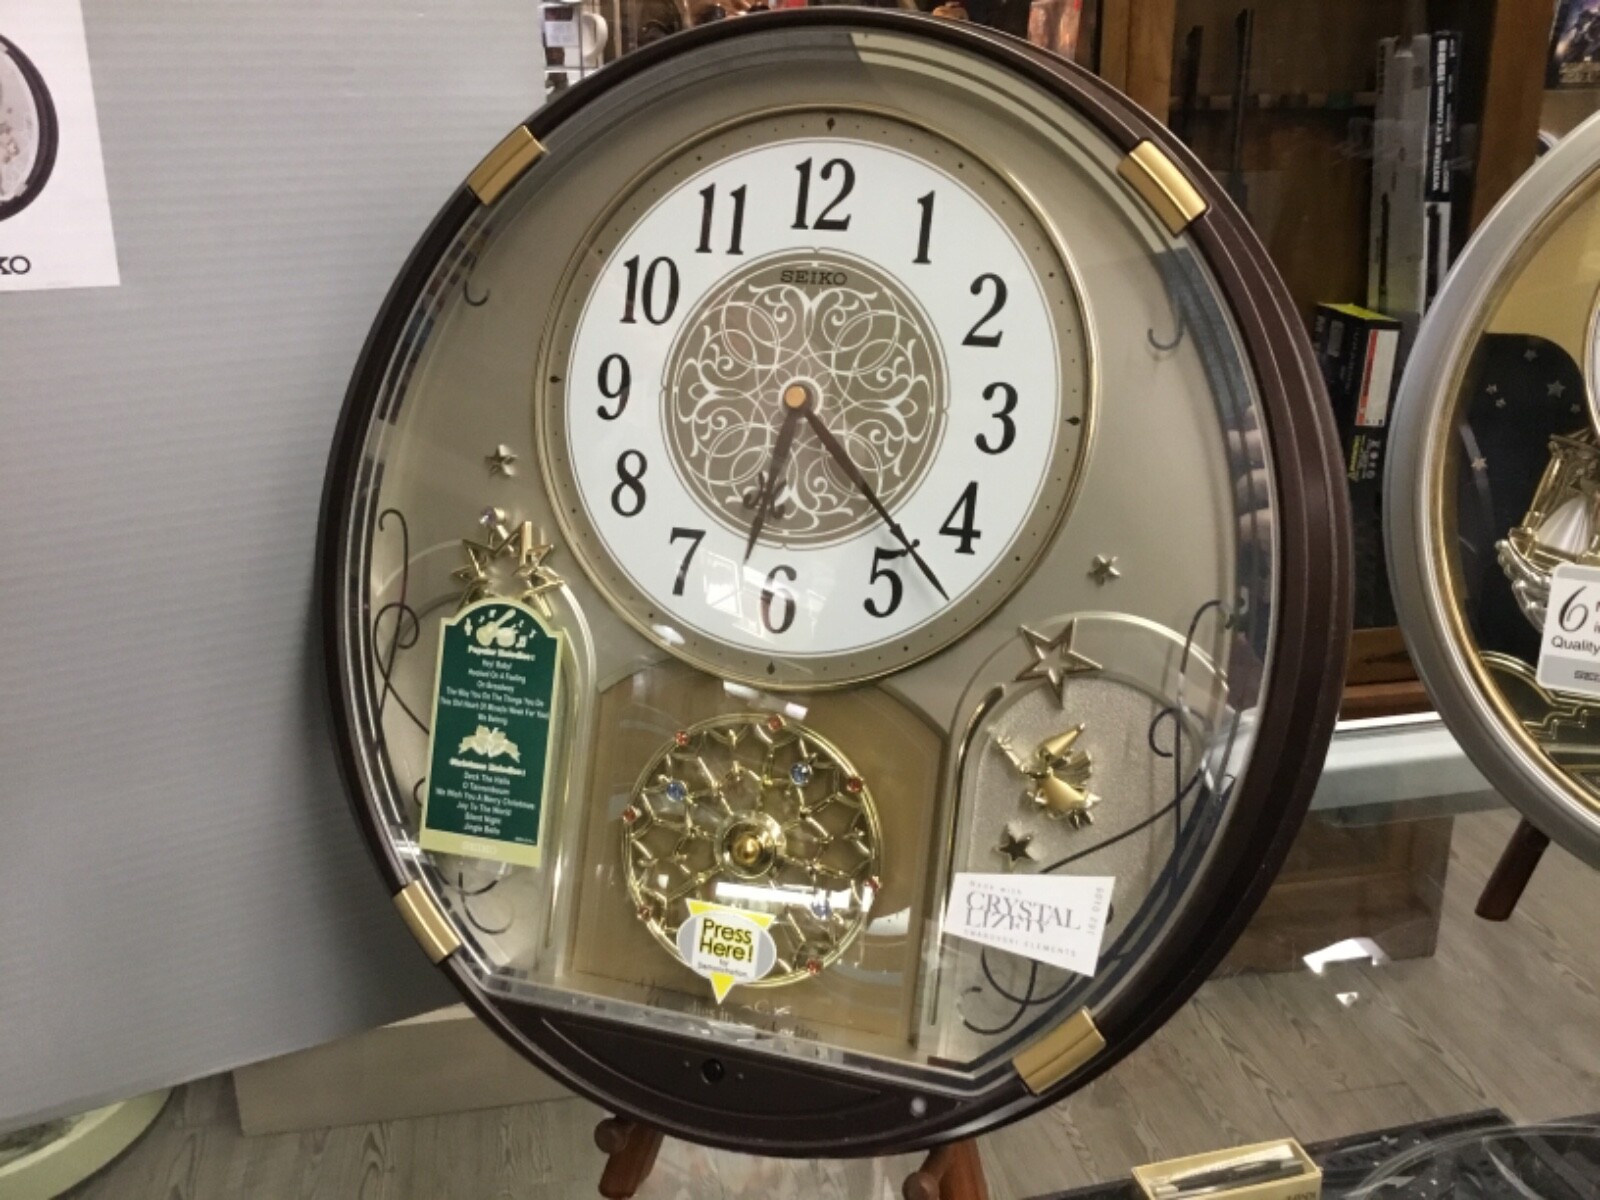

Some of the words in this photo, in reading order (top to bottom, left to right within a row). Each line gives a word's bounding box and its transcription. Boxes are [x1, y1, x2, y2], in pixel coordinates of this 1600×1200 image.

[695, 182, 747, 255] 11
[791, 157, 856, 231] 12
[912, 190, 936, 265] 1
[620, 255, 680, 326] 10
[780, 270, 848, 286] SEIKO
[961, 272, 1008, 348] 2
[596, 353, 631, 421] 9
[974, 382, 1019, 455] 3
[610, 449, 648, 517] 8
[939, 481, 982, 555] 4
[669, 527, 706, 596] 7
[864, 545, 905, 618] 5
[760, 564, 797, 634] 6
[702, 918, 752, 944] Press
[965, 890, 1081, 931] CRYSTAL
[699, 937, 754, 963] Here!
